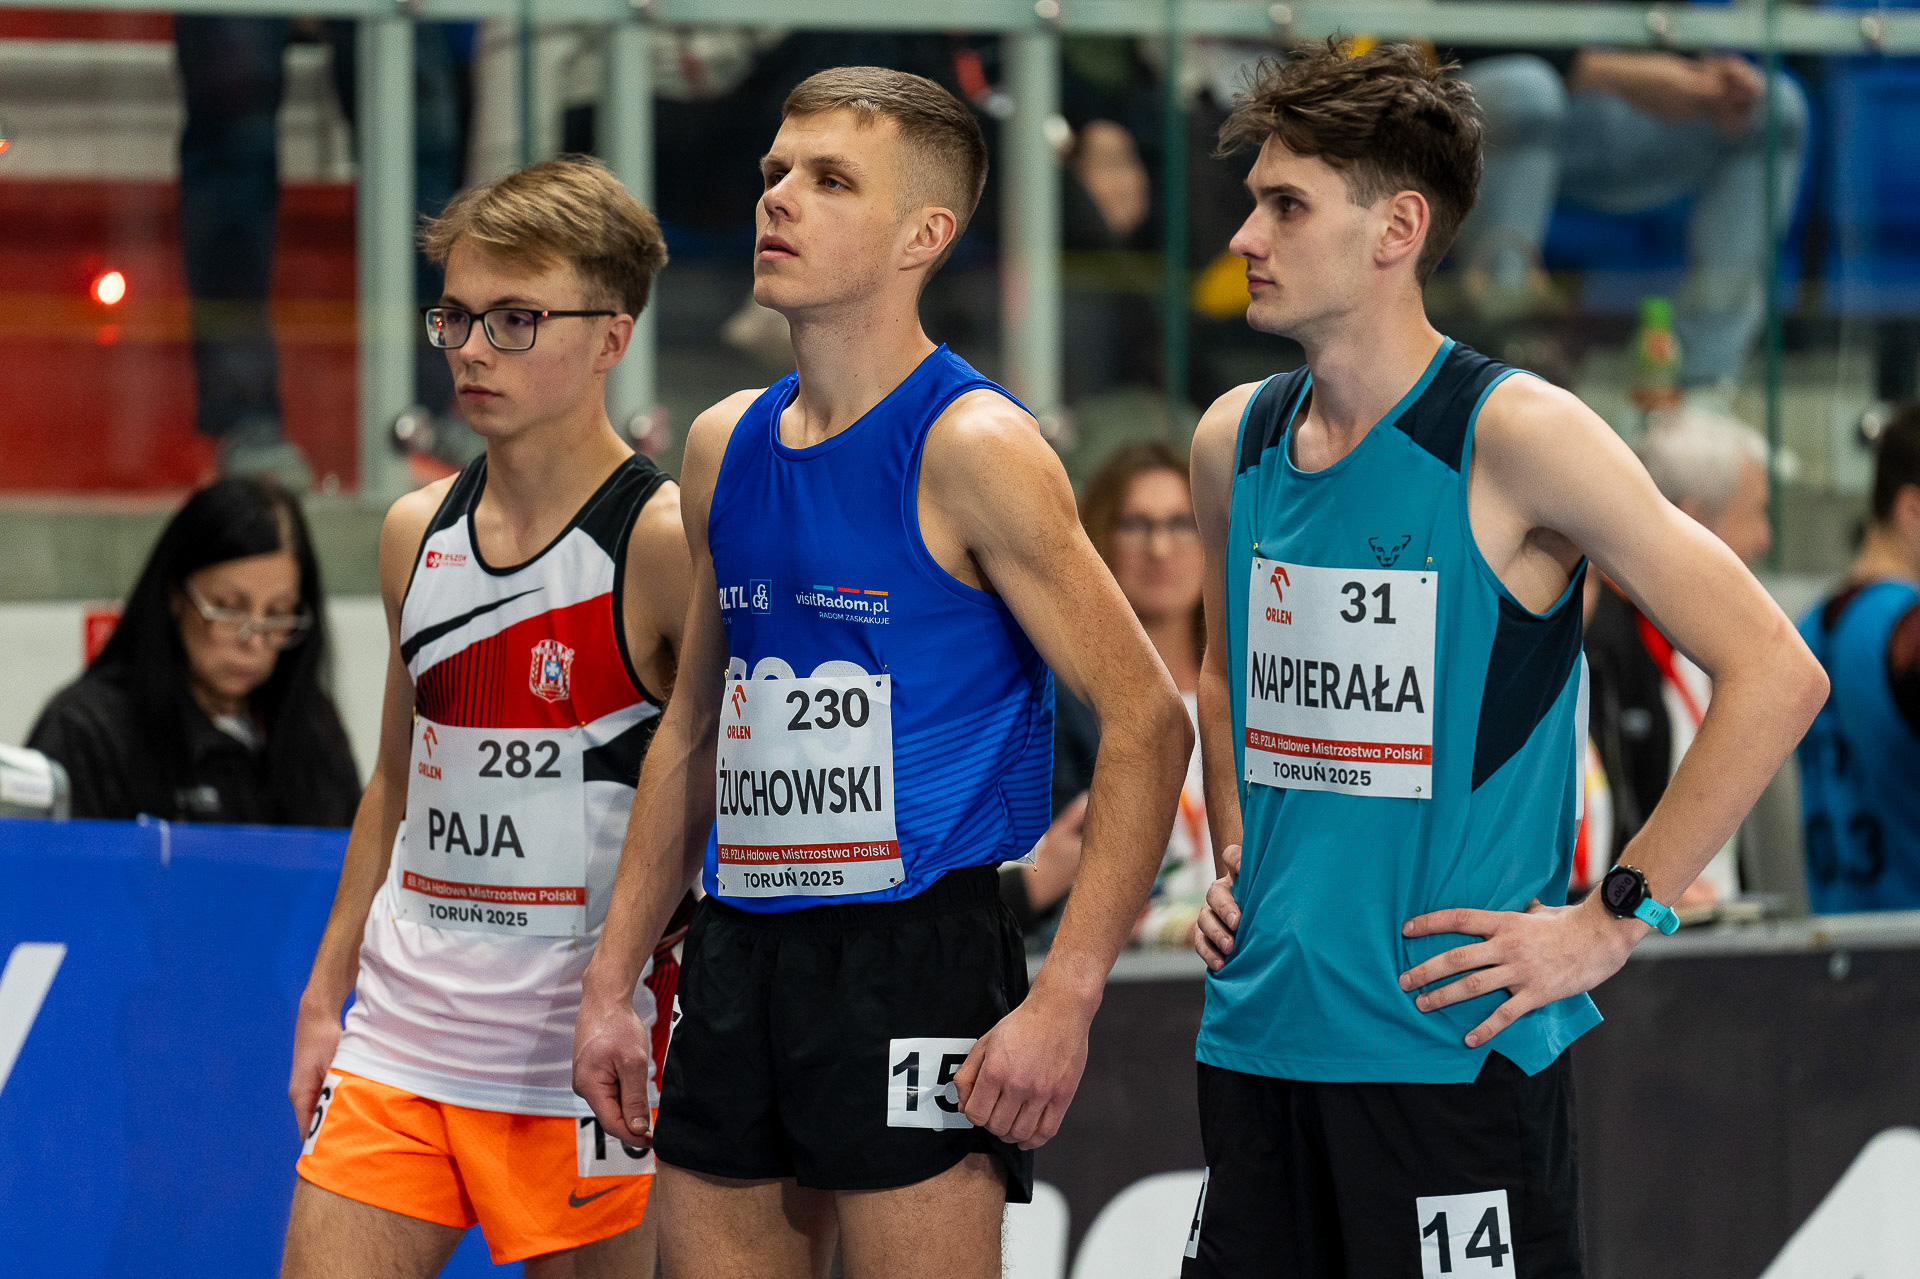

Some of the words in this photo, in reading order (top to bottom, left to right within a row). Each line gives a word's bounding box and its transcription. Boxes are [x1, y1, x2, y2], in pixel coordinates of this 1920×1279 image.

[796, 591, 889, 615] visitRadom.pl
[1340, 581, 1396, 624] 31
[819, 611, 844, 620] RADOM
[845, 614, 889, 625] ZASKAKUJE
[1265, 606, 1292, 625] ORLEN
[1251, 651, 1424, 714] NAPIERAŁA
[786, 687, 870, 730] 230
[727, 725, 751, 740] ORLEN
[478, 740, 561, 778] 282
[1260, 734, 1276, 749] PZLA
[1277, 737, 1310, 753] Halowe
[1312, 742, 1380, 759] Mistrzostwa
[1384, 747, 1423, 761] Polski
[418, 762, 442, 781] ORLEN
[1273, 761, 1326, 782] TORUŃ
[1329, 767, 1371, 786] 2025
[719, 757, 882, 817] ŻUCHOWSKI
[428, 807, 525, 858] PAJA
[730, 848, 746, 860] PZLA
[746, 849, 780, 861] Halowe
[781, 847, 850, 860] Mistrzostwa
[853, 844, 890, 858] Polski
[744, 867, 798, 888] TORUŃ
[800, 870, 844, 887] 2025
[432, 884, 467, 896] Halowe
[468, 887, 536, 901] Mistrzostwa
[539, 889, 577, 902] Polski
[428, 904, 483, 922] TORUŃ
[486, 909, 528, 926] 2025
[893, 1052, 970, 1113] 15
[1423, 1206, 1509, 1273] 14
